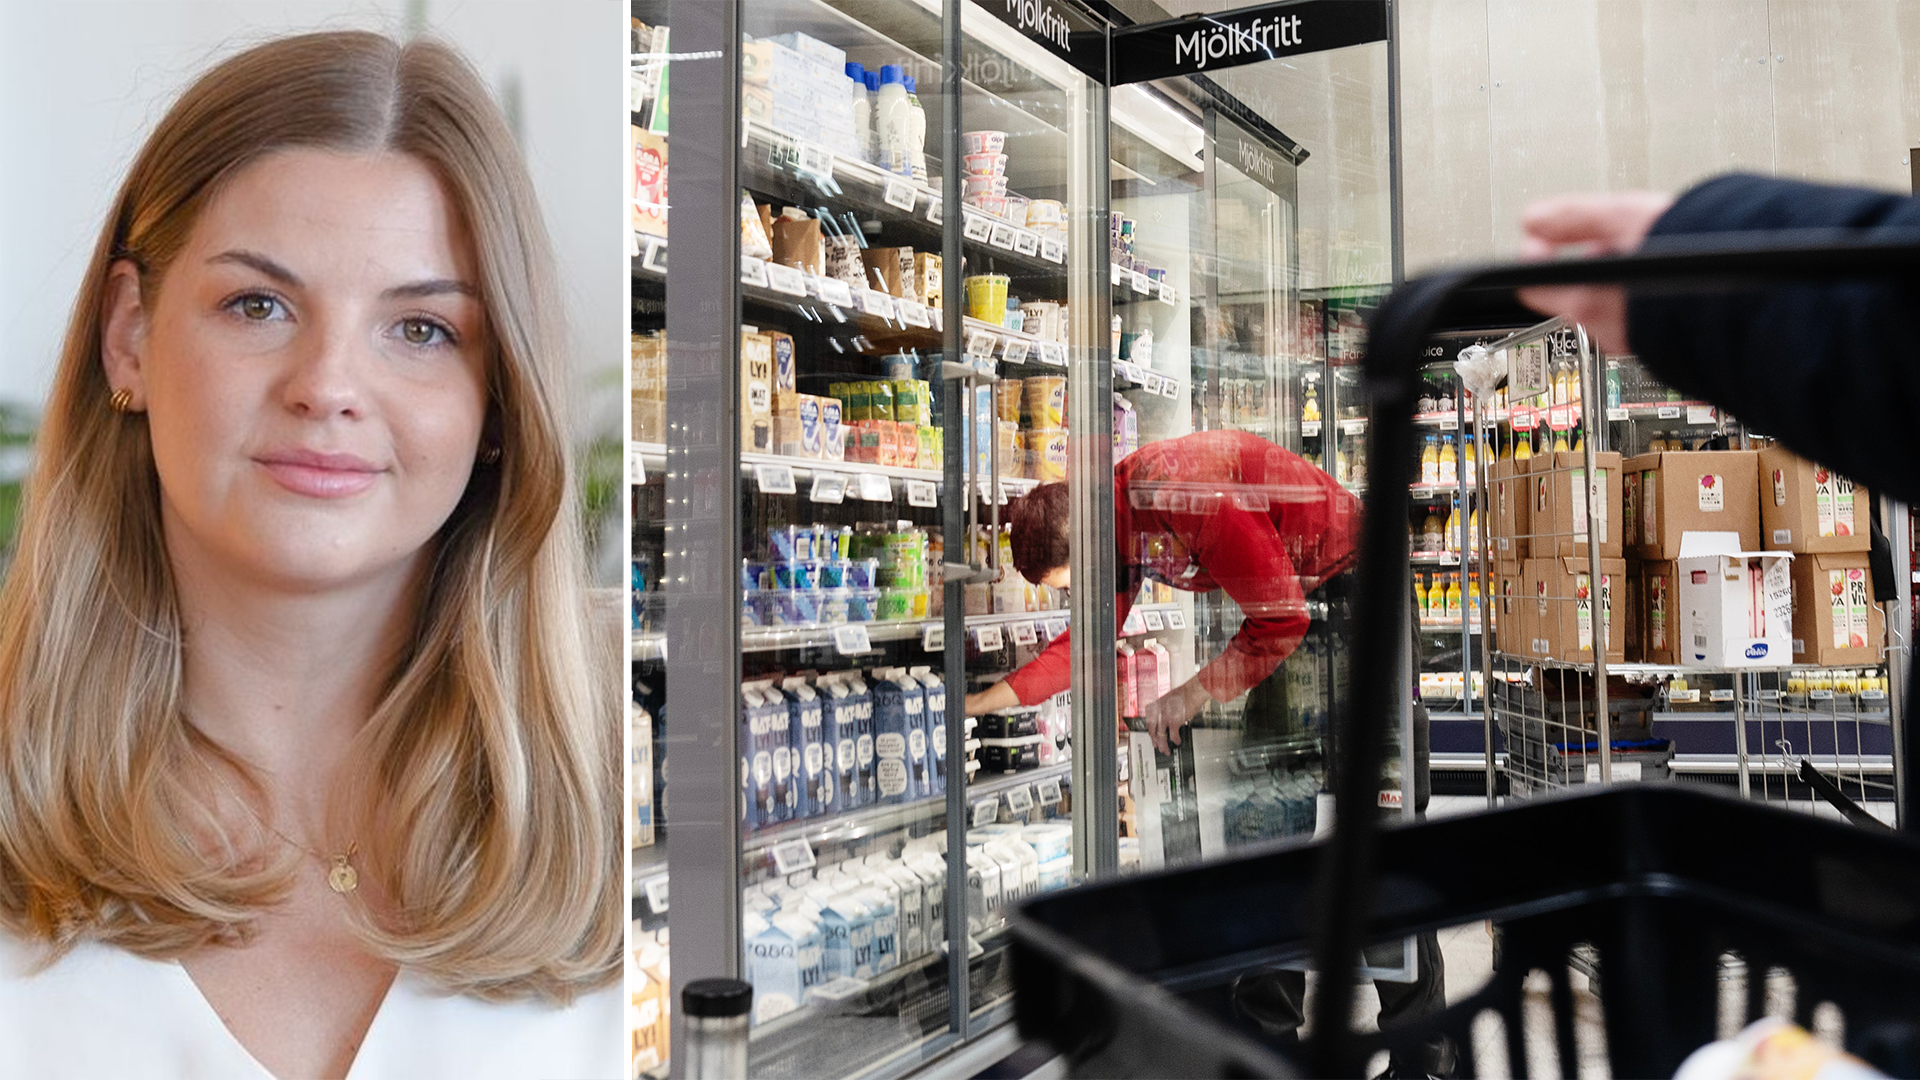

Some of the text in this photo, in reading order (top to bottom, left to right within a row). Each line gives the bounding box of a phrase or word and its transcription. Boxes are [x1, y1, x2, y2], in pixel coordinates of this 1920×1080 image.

[1175, 14, 1302, 69] Mjölkfritt
[1238, 138, 1275, 184] Mjölkfritt
[750, 361, 767, 378] LY!
